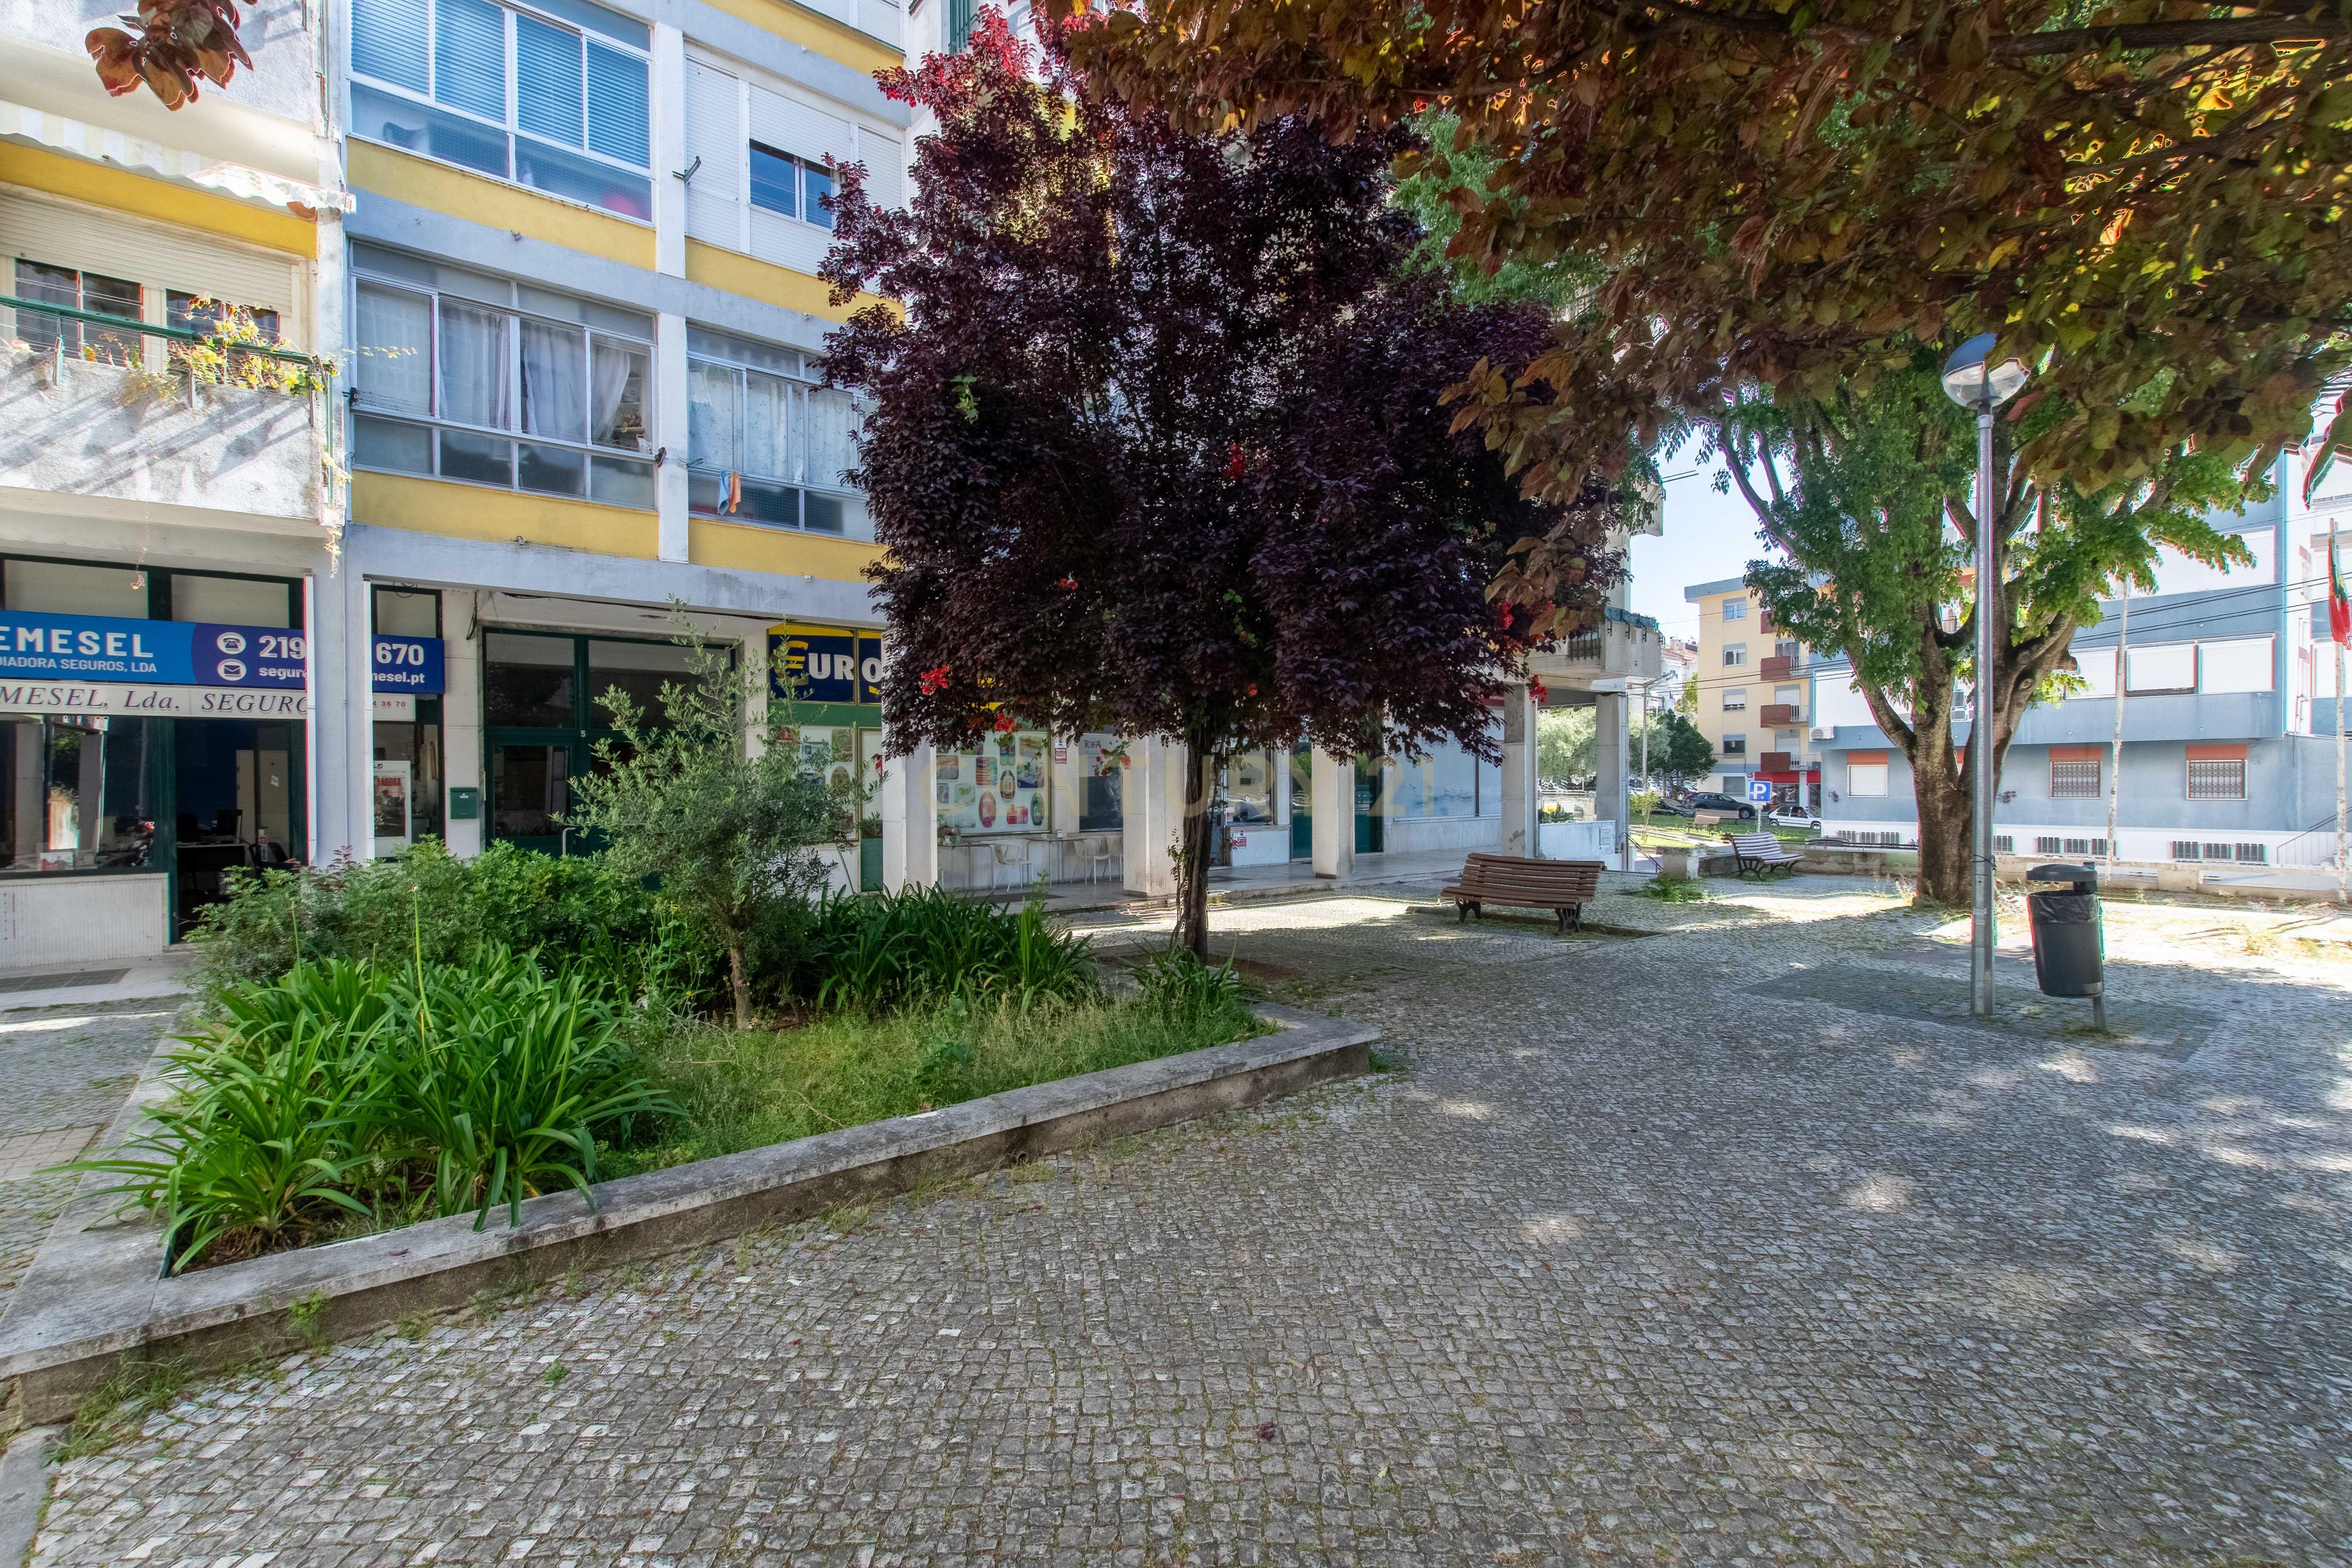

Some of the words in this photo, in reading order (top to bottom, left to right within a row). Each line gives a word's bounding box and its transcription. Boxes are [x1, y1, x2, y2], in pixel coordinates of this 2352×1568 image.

[259, 636, 306, 659] 219
[376, 642, 424, 665] 670
[0, 656, 57, 668] IADORA
[61, 659, 128, 672] SEGUROS,
[131, 662, 157, 672] LDA
[124, 691, 180, 709] Lda.
[1754, 784, 1766, 799] P
